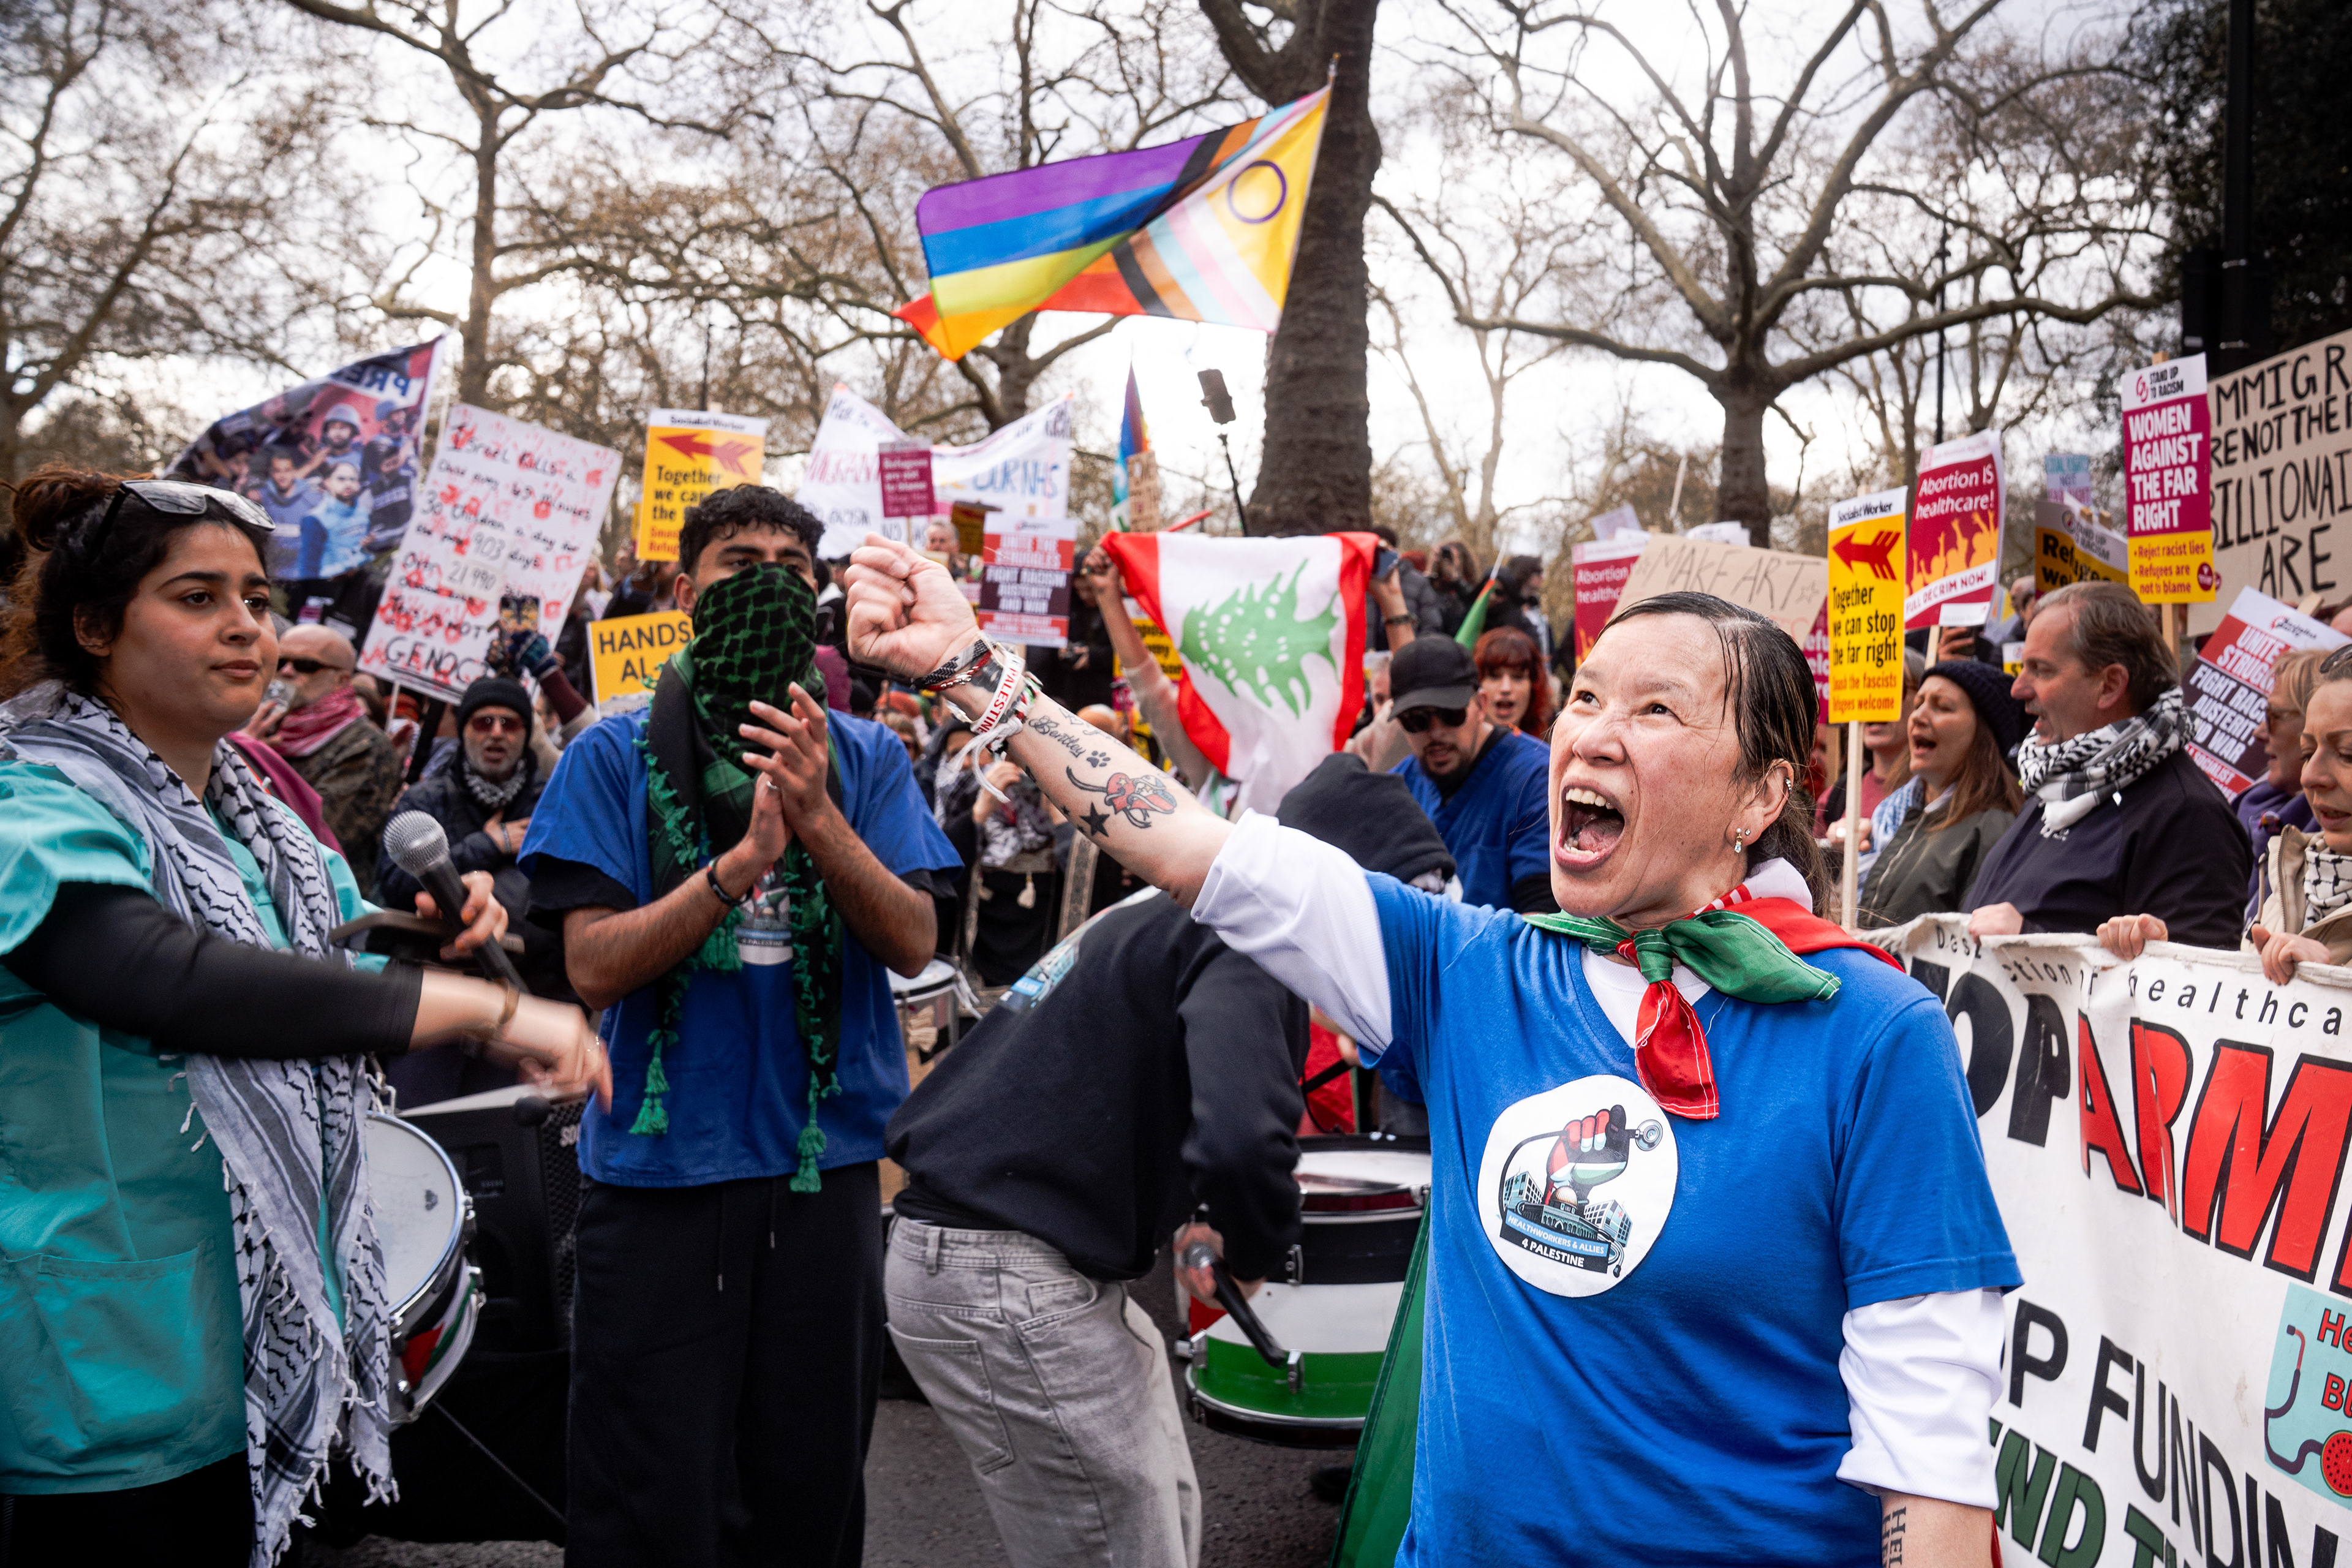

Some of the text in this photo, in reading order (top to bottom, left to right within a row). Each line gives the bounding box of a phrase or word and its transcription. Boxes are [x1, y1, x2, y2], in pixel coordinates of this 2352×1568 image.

[2150, 366, 2179, 384] STAND UP
[2150, 379, 2184, 398] TO RACISM
[2216, 344, 2351, 427] MMIGR
[2128, 402, 2192, 443] WOMEN
[2211, 428, 2237, 467] RE
[2242, 412, 2287, 462] NOT
[2291, 397, 2340, 445] THE
[2130, 432, 2203, 472] AGAINST
[657, 465, 721, 486] Together
[1021, 459, 1060, 499] NHS
[1918, 464, 1994, 497] Abortion IS
[2131, 466, 2199, 502] THE FAR
[655, 489, 674, 502] we
[1864, 501, 1892, 516] Worker
[1915, 489, 1994, 520] healthcare!
[2211, 449, 2352, 551] ILLIONAI
[653, 505, 676, 521] the
[2133, 499, 2181, 532] RIGHT
[473, 531, 506, 561] 903
[649, 541, 679, 556] Refug
[2162, 541, 2187, 557] racist
[2189, 540, 2206, 555] lies
[2260, 523, 2336, 598] ARE
[1577, 565, 1629, 585] Abortion
[1642, 544, 1821, 611] MAKE ART
[2139, 564, 2190, 579] Refugees are
[2139, 582, 2154, 594] not
[2163, 579, 2191, 595] blame
[1577, 586, 1622, 605] healthc
[1833, 582, 1874, 614] Together
[1905, 569, 1987, 614] FULL DECRIM NOW!
[599, 620, 691, 655] HANDS
[1845, 617, 1861, 636] can
[1866, 609, 1896, 638] stop
[1847, 641, 1860, 665] far
[1866, 637, 1897, 668] right
[2237, 625, 2286, 664] UNITE
[1849, 674, 1860, 690] the
[1863, 671, 1897, 690] fascists
[2189, 663, 2237, 703] FIGHT
[1857, 693, 1895, 710] welcome
[1028, 716, 1086, 759] Bentley
[2207, 729, 2247, 765] WAR
[2194, 750, 2236, 785] SOCIALIST
[1910, 956, 2071, 1148] OP
[559, 1124, 579, 1147] SO
[2079, 1009, 2352, 1298] ARM
[1507, 1215, 1570, 1247] HEALTHWORKERS
[1579, 1243, 1604, 1254] ALLIES
[1521, 1238, 1585, 1268] 4 PALESTINE
[2008, 1298, 2069, 1409] P
[2083, 1334, 2339, 1568] FUNDIN
[1991, 1415, 2107, 1568] ND
